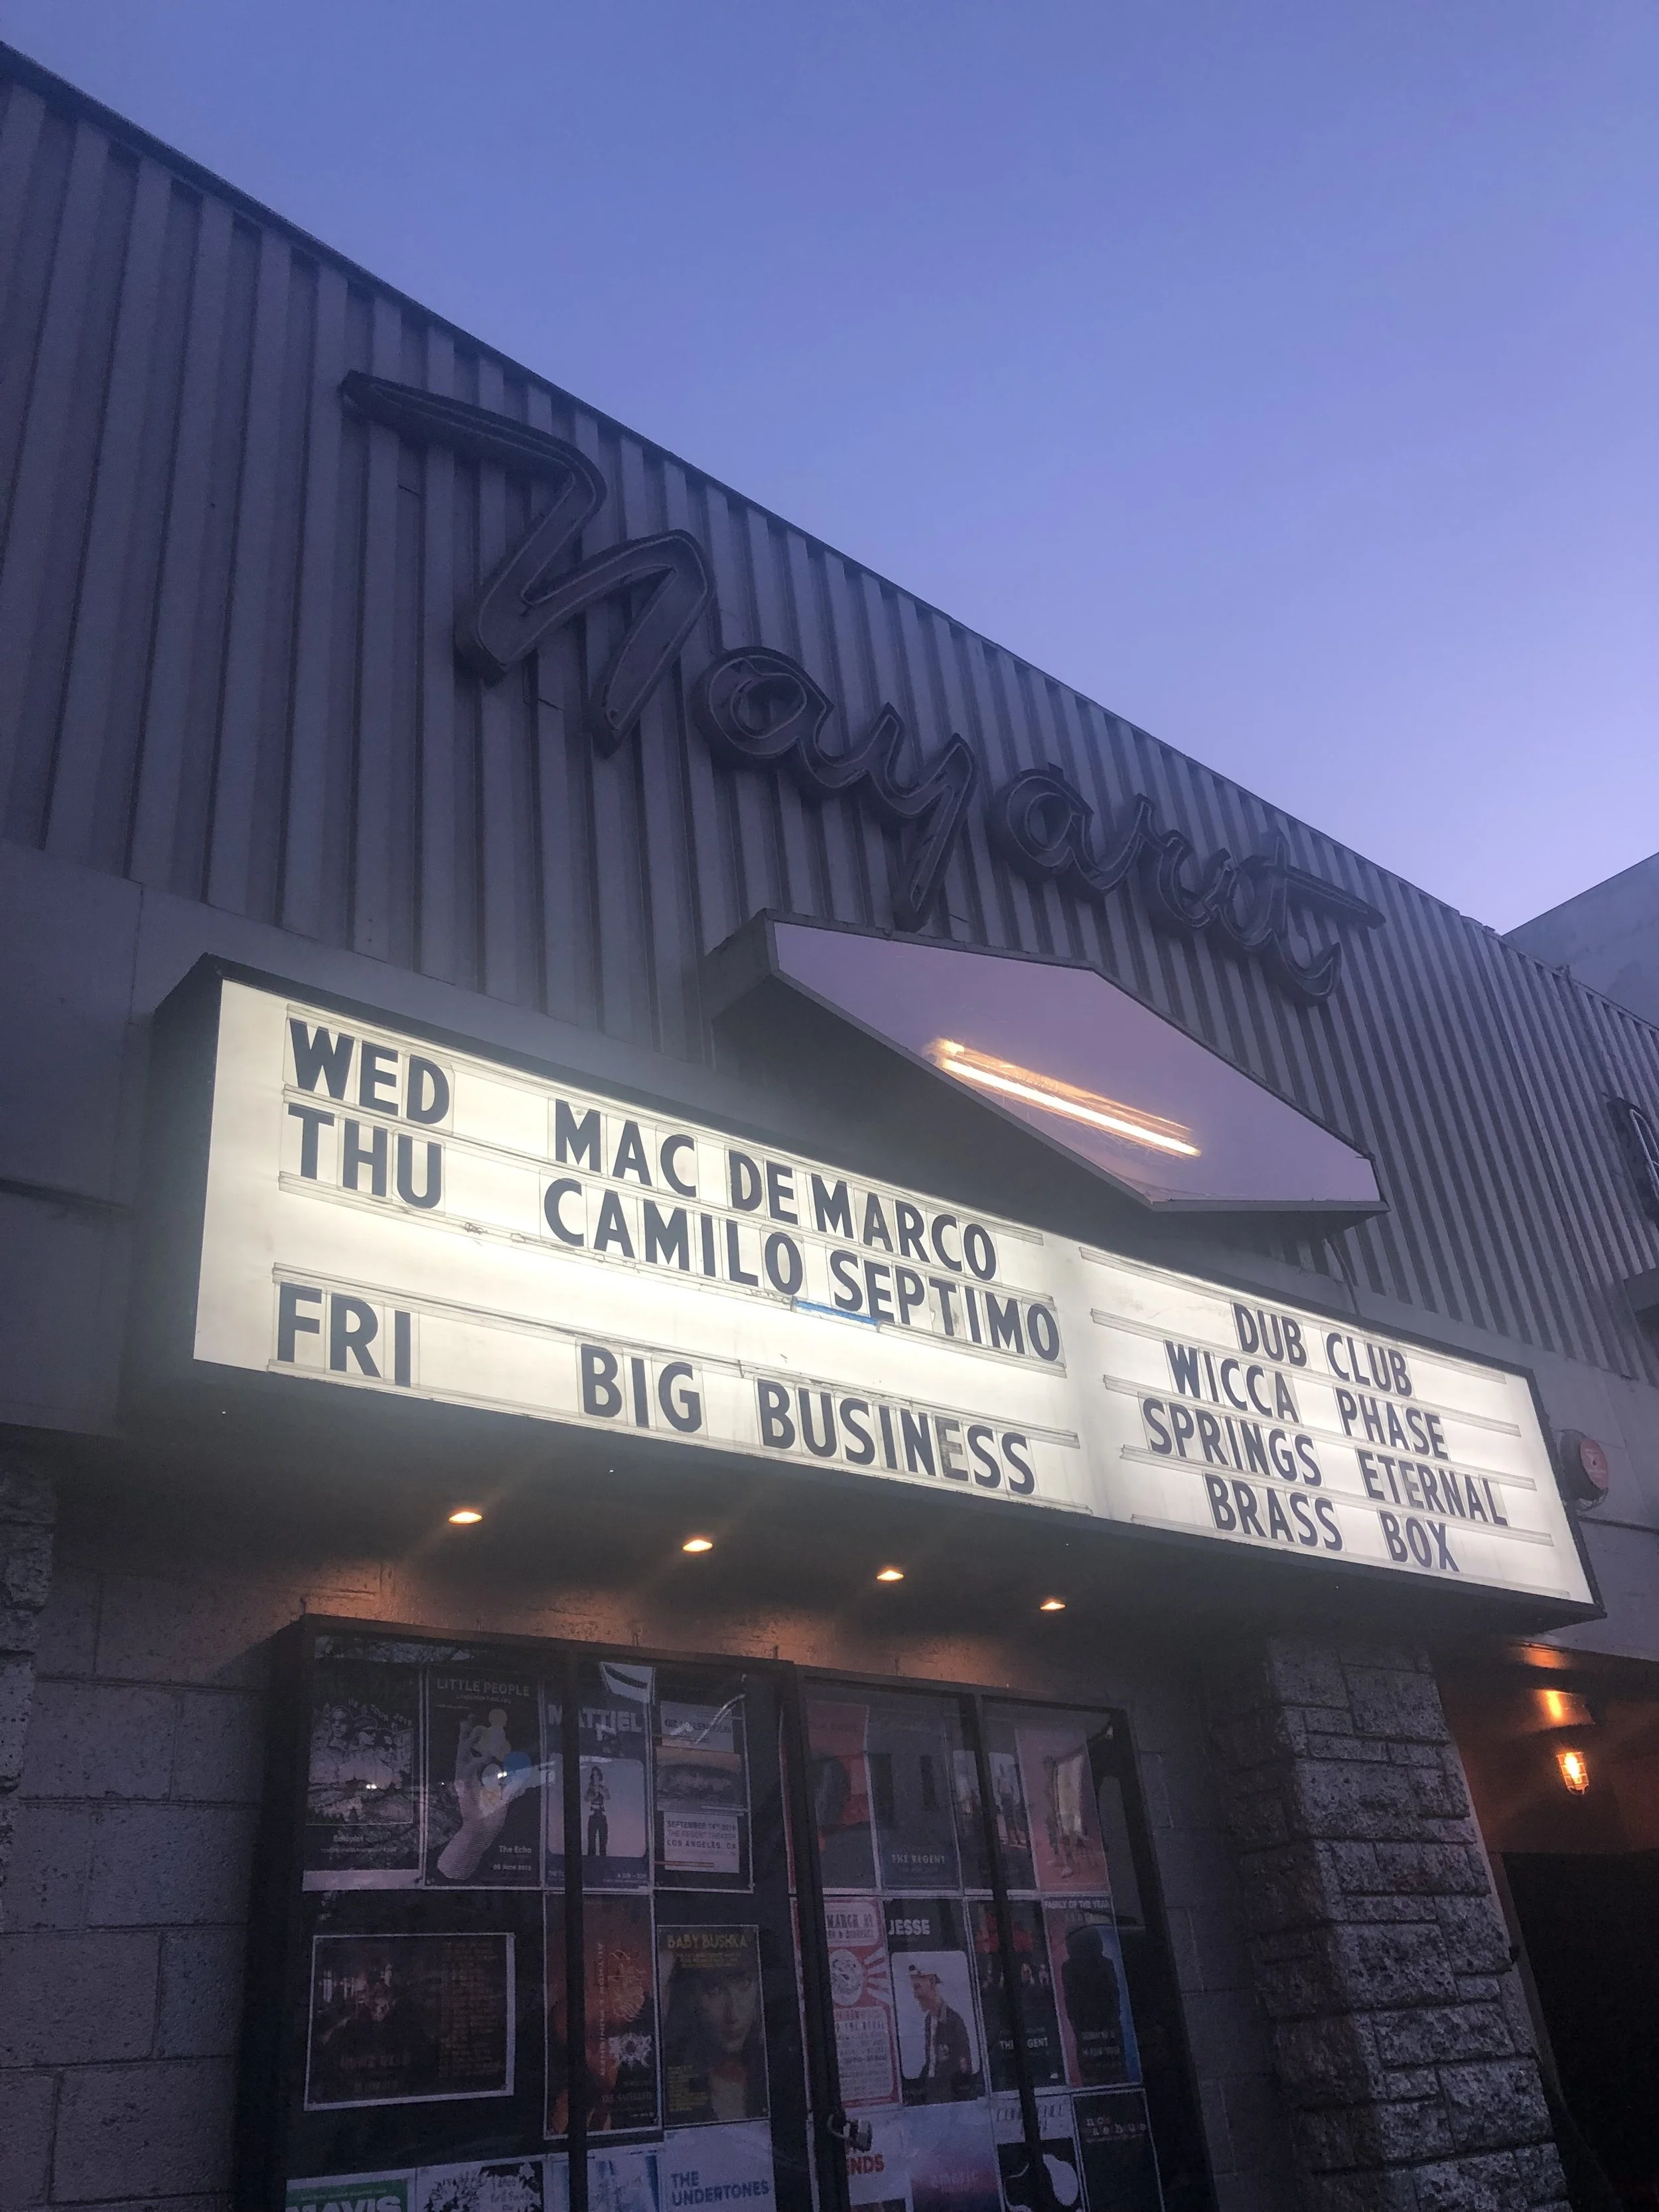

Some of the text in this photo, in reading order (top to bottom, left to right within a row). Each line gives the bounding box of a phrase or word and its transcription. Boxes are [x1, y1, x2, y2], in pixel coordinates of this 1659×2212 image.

[288, 1017, 450, 1126] WED
[555, 1098, 697, 1198] MAC
[287, 1103, 1060, 1361] THU CAMILO SEPTIMO
[1232, 1303, 1413, 1396] DUB CLUB
[277, 1282, 1036, 1495] FRI BIG BUSINESS
[1165, 1339, 1449, 1460] WICCA PHASE
[1142, 1397, 1509, 1526] SPRINGS ETERNAL
[1202, 1471, 1459, 1572] BRASS BOX
[436, 1677, 530, 1697] LITTLE PEOPLE
[547, 1705, 642, 1734] MTTIEL
[499, 1845, 532, 1854] The Echo
[667, 1933, 748, 1949] BABY BUSHKA
[889, 1919, 930, 1935] JESSE
[670, 2171, 699, 2189] THE
[672, 2179, 770, 2207] UNDERTONES
[285, 2195, 402, 2212] VIS
